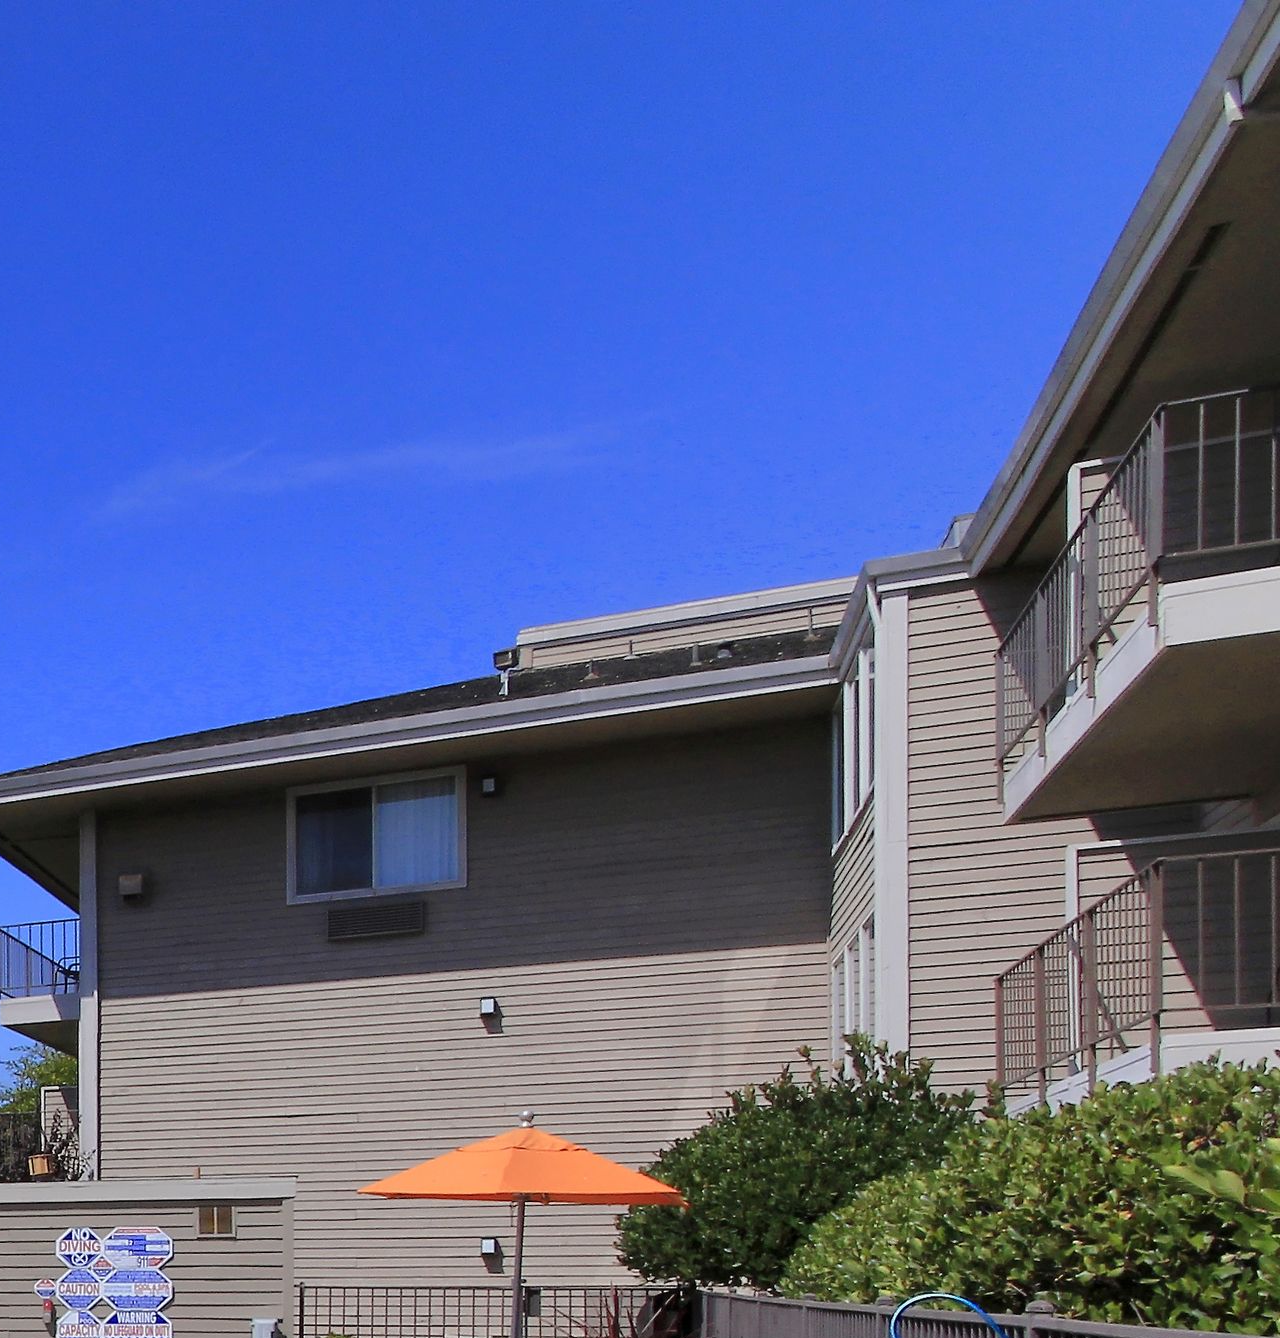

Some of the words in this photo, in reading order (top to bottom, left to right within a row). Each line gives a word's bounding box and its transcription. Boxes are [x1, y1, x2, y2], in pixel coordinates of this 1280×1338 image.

[72, 1228, 90, 1240] NO
[59, 1241, 101, 1252] DIVING
[137, 1256, 148, 1267] 911
[58, 1283, 100, 1294] CAUTION
[116, 1311, 157, 1323] WARNING
[59, 1324, 100, 1336] CAPACITY
[104, 1324, 113, 1337] NO
[114, 1324, 145, 1337] LIFEGUARD
[145, 1324, 154, 1337] ON
[155, 1324, 170, 1337] DUTY
